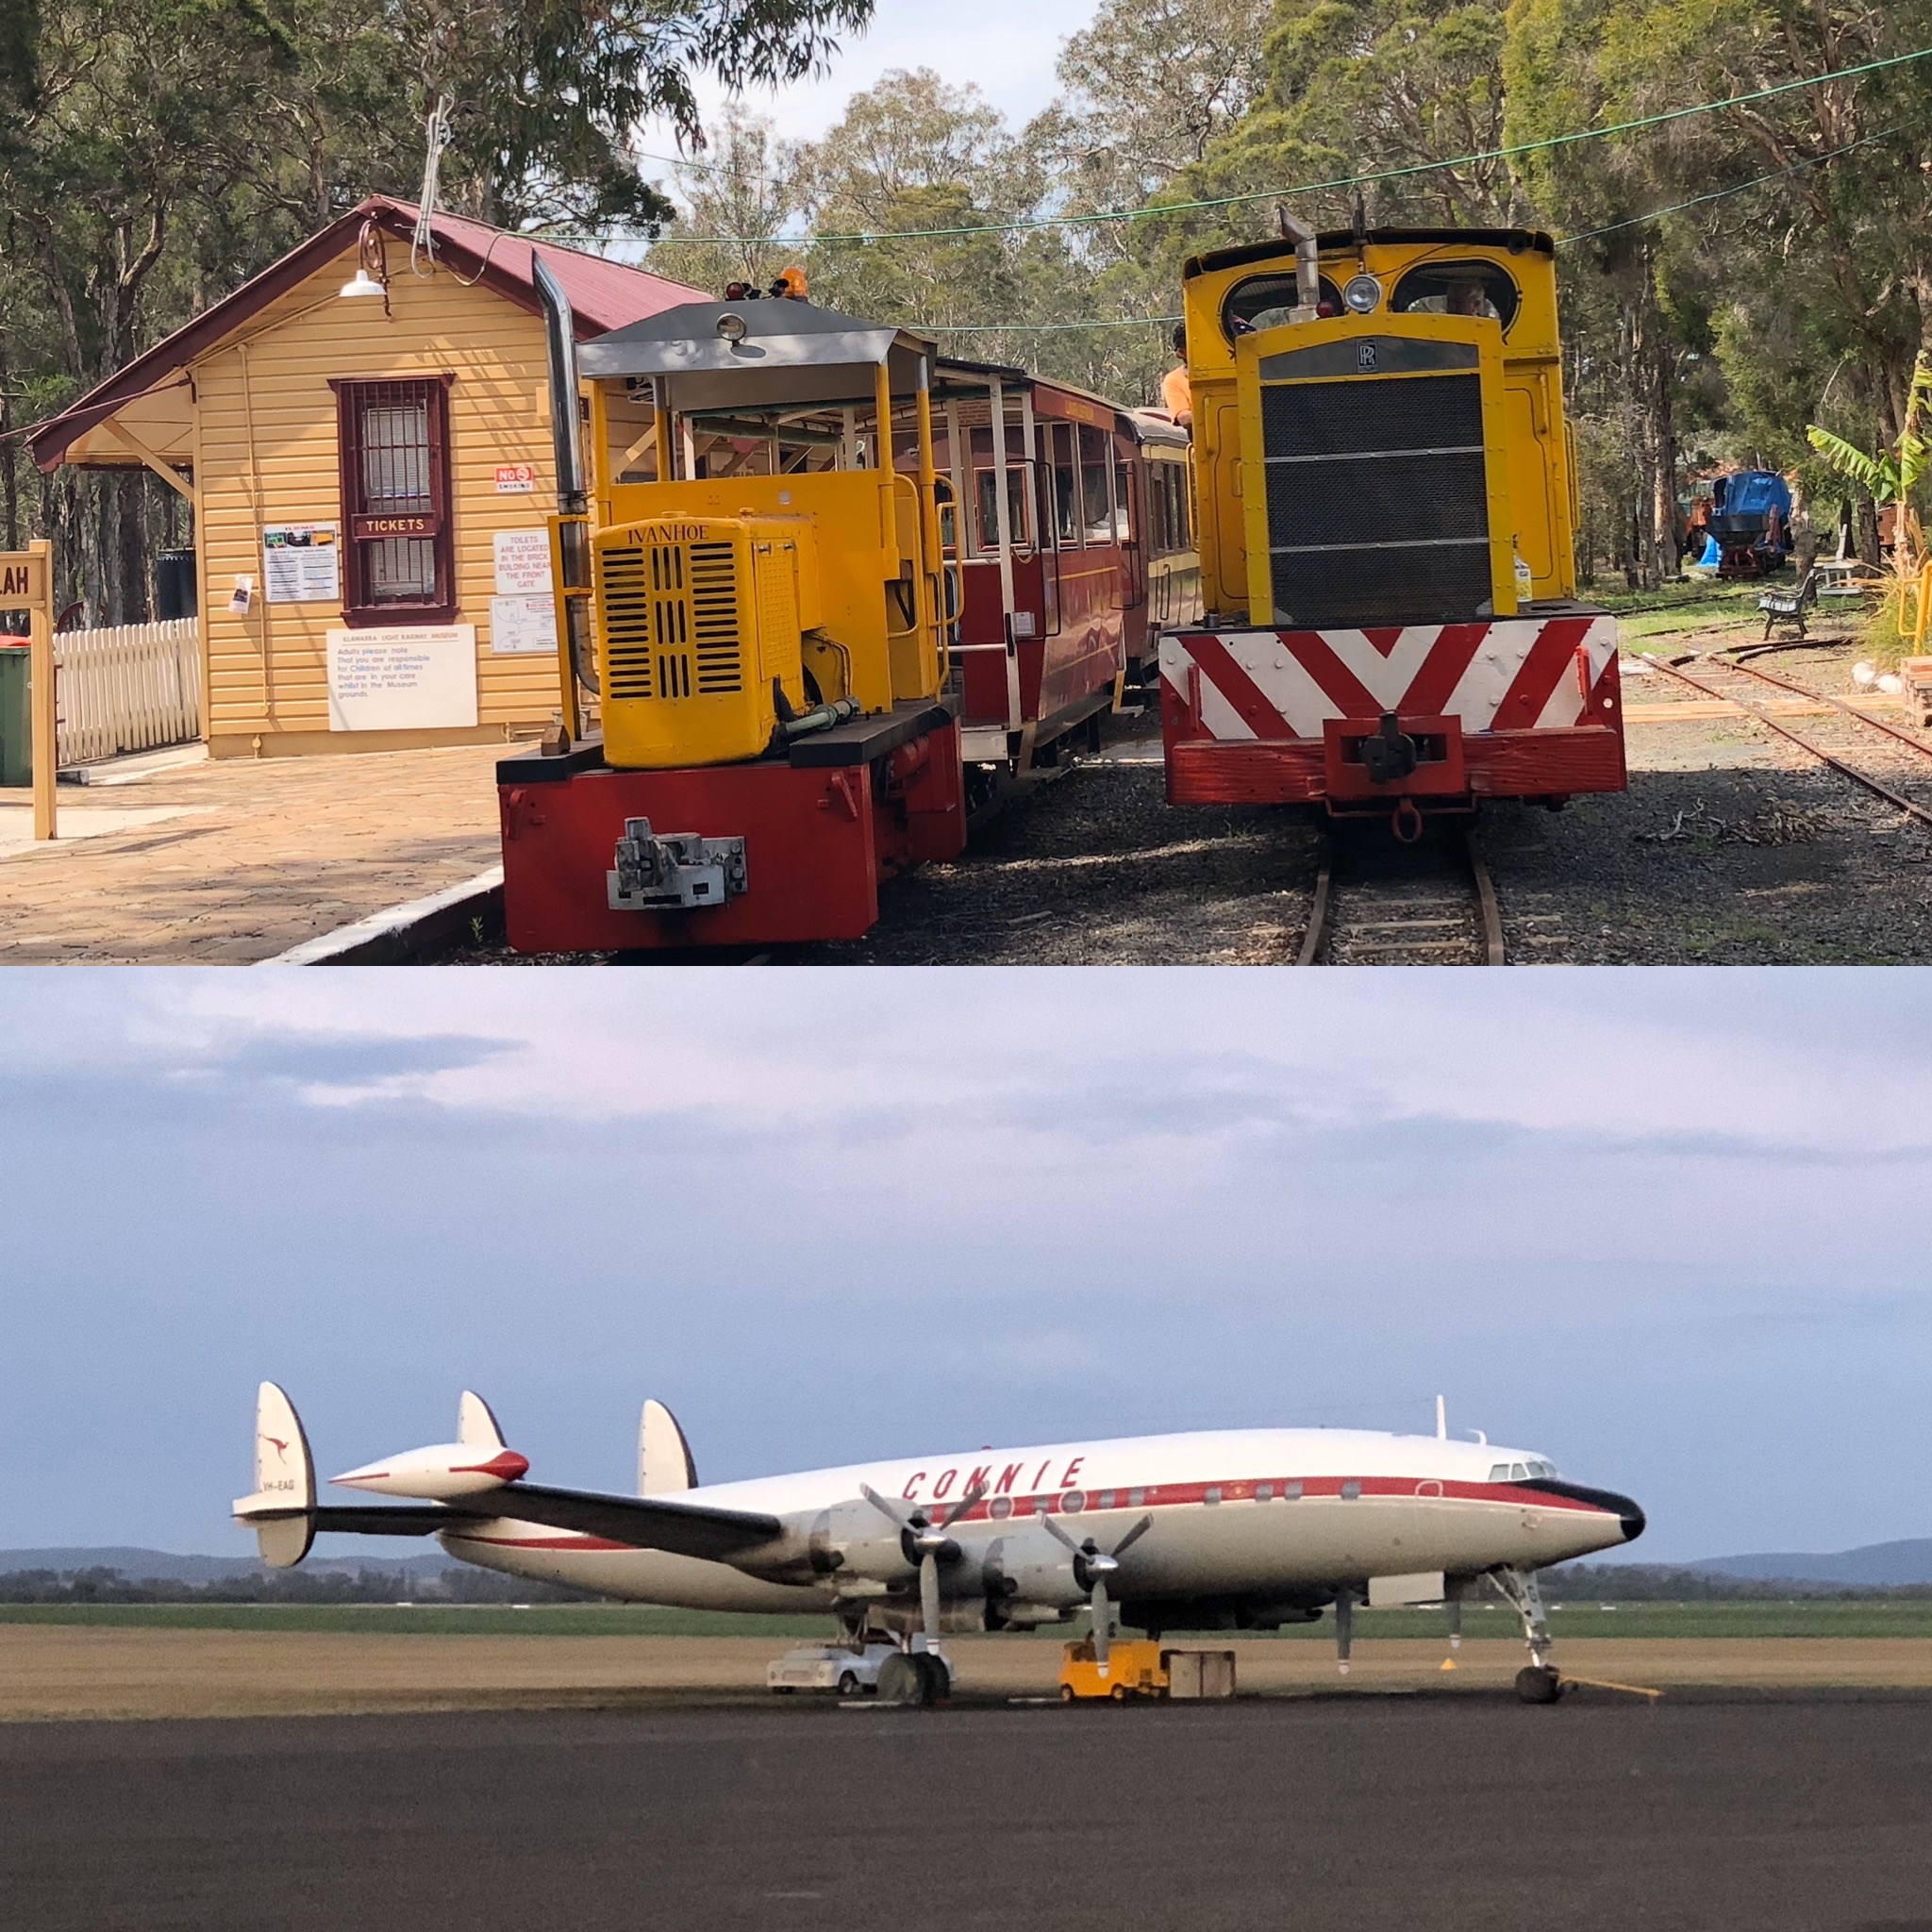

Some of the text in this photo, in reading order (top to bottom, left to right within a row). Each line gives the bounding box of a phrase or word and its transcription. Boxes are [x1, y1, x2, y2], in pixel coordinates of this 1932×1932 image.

[498, 470, 516, 480] NO
[366, 518, 425, 532] TICKETS
[628, 524, 709, 544] IVANHOE
[509, 536, 539, 544] TOILETS
[517, 544, 549, 553] LOCATED
[498, 563, 530, 572] BUILDING
[0, 566, 29, 595] AH
[506, 571, 545, 580] THE FRONT
[362, 647, 388, 657] please
[355, 657, 369, 665] you
[388, 655, 431, 664] responsible
[381, 674, 397, 682] your
[387, 680, 418, 689] Museum
[338, 691, 369, 699] grounds.
[902, 1457, 1085, 1501] CONNIE
[263, 1479, 295, 1491] VH-EAG
